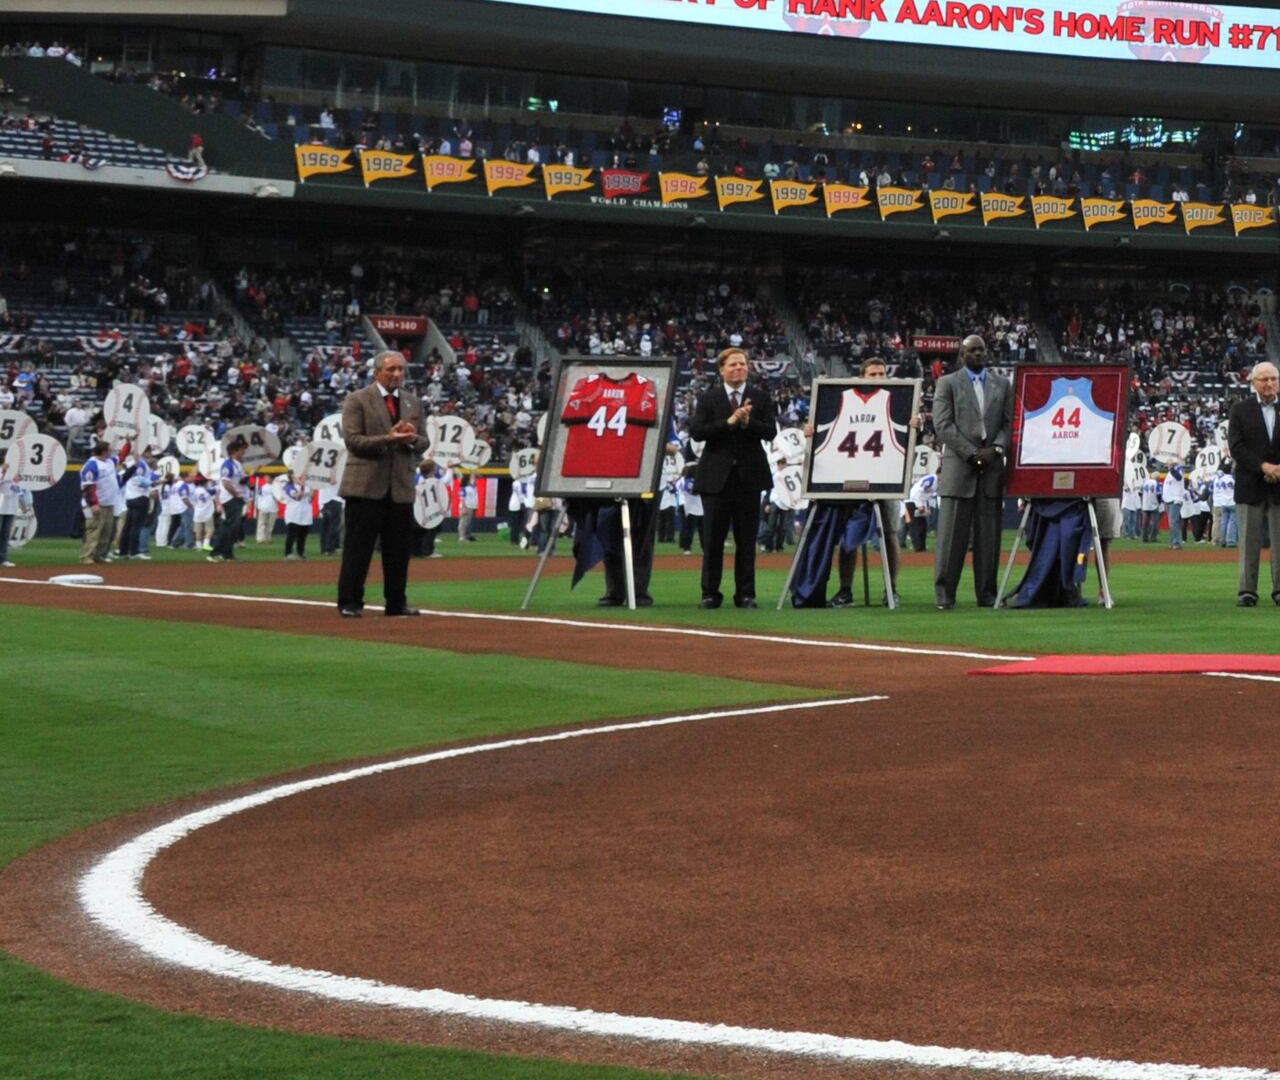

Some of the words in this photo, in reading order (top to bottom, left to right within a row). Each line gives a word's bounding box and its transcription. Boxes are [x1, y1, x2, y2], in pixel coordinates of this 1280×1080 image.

[1053, 11, 1145, 43] HOME
[1153, 19, 1221, 48] RUN
[301, 152, 340, 167] 1969
[366, 157, 403, 171] 1982
[429, 162, 463, 177] 1991
[489, 165, 524, 181] 1992
[549, 171, 582, 186] 1993
[605, 175, 641, 190] 1995
[664, 179, 698, 194] 1996
[720, 183, 753, 198] 1997
[775, 187, 807, 200] 1998
[828, 191, 860, 204] 1999
[879, 194, 914, 207] 2000
[934, 197, 966, 210] 2001
[983, 199, 1016, 213] 2002
[1034, 201, 1066, 215] 2003
[1083, 204, 1117, 217] 2004
[1133, 206, 1167, 219] 2005
[1234, 210, 1265, 223] 2012
[603, 389, 625, 399] AARON
[123, 393, 133, 412] 4
[587, 406, 628, 437] 44
[850, 415, 876, 424] AARON
[1052, 408, 1081, 428] 44
[187, 431, 205, 444] 32
[439, 424, 462, 443] 12
[1052, 431, 1079, 439] AARON
[1167, 429, 1176, 444] 7
[837, 430, 884, 458] 44
[30, 443, 44, 465] 3
[310, 448, 339, 468] 43
[519, 453, 535, 469] 64
[1200, 450, 1222, 466] 201
[784, 472, 802, 491] 61
[421, 486, 437, 507] 11
